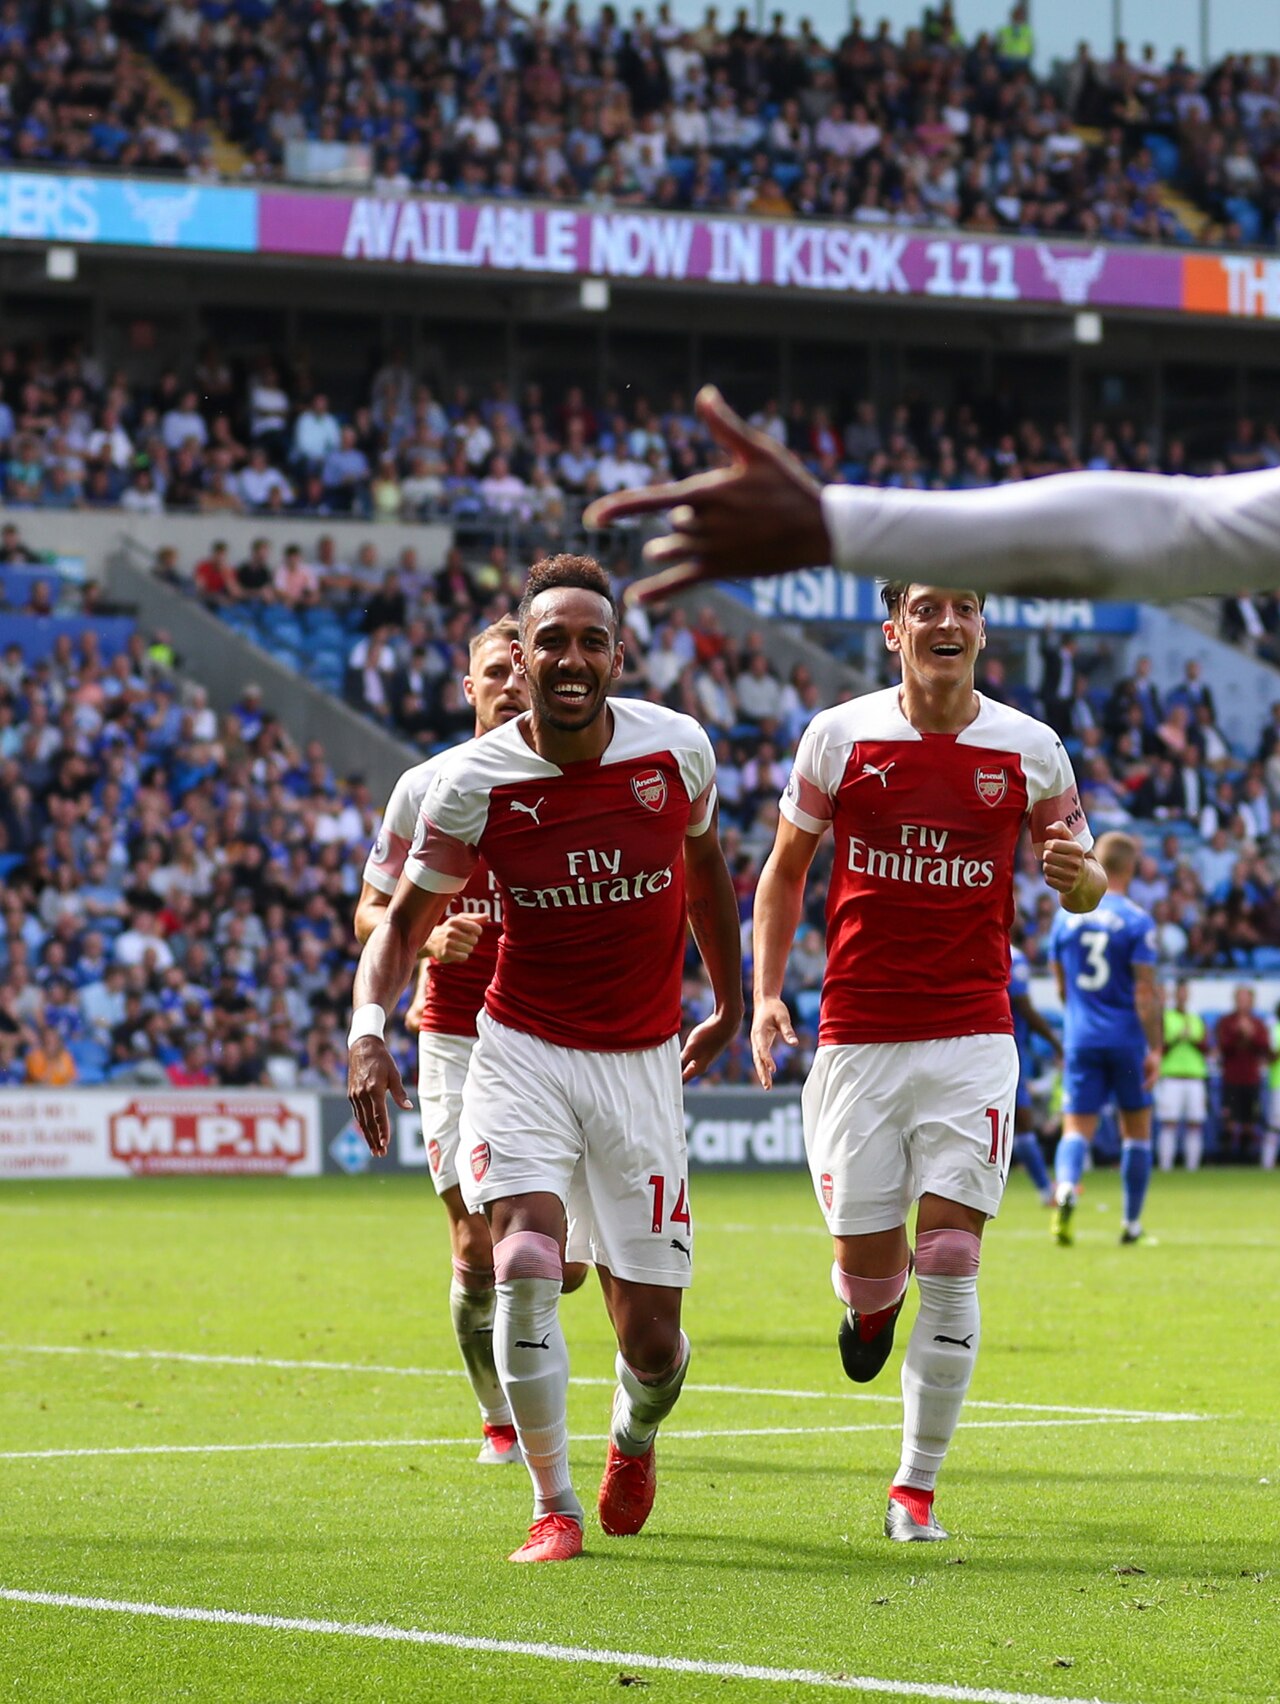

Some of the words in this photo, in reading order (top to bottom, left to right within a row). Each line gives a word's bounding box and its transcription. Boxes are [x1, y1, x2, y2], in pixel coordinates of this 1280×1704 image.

[0, 173, 99, 241] ERS
[342, 196, 578, 273] AVAILABLE
[589, 212, 693, 281] NOW
[708, 219, 762, 285] IN
[773, 226, 910, 294] KISOK
[924, 241, 1020, 300] 111
[566, 848, 621, 877] Fly
[847, 835, 994, 889] Emirates
[901, 824, 949, 854] Fly
[509, 863, 673, 910] Emirates
[1075, 930, 1108, 992] 3
[114, 1115, 302, 1154] M.P.N
[684, 1104, 802, 1163] ardi
[648, 1175, 691, 1236] 14
